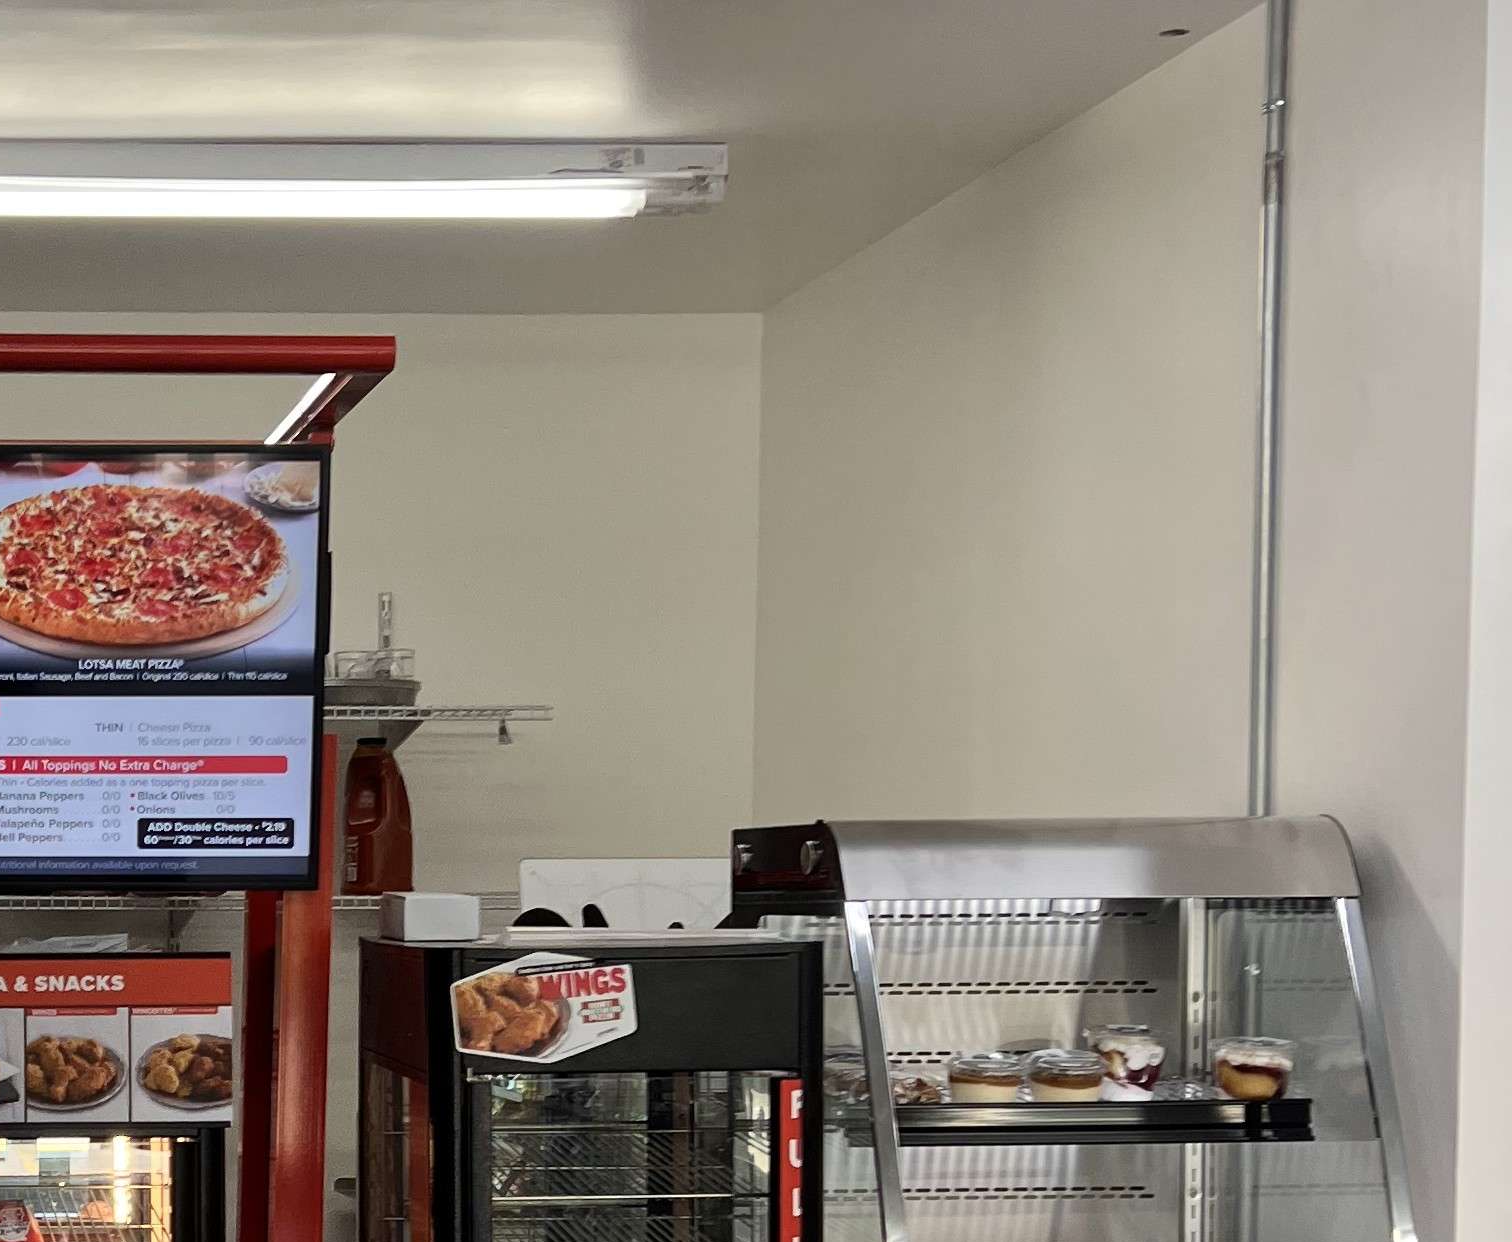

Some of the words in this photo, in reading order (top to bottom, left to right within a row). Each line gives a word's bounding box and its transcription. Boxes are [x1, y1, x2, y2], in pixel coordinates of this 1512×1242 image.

[78, 659, 114, 669] LOTSA
[115, 659, 146, 669] MEAT
[95, 722, 124, 733] THIN
[182, 722, 212, 733] Pizza
[22, 759, 38, 770] All
[41, 759, 96, 774] Toppings
[98, 759, 117, 771] No
[119, 759, 150, 771] Extra
[39, 791, 85, 802] Peppers
[138, 791, 168, 801] Black
[170, 791, 205, 801] Olives
[137, 805, 176, 815] Onions
[48, 819, 94, 830] Peppers
[147, 822, 173, 832] ADD
[174, 822, 212, 832] Double
[213, 822, 253, 832] Cheese
[17, 833, 63, 844] Peppers
[13, 976, 29, 992] &
[34, 975, 125, 993] SNACKS
[538, 967, 627, 1002] WINGS
